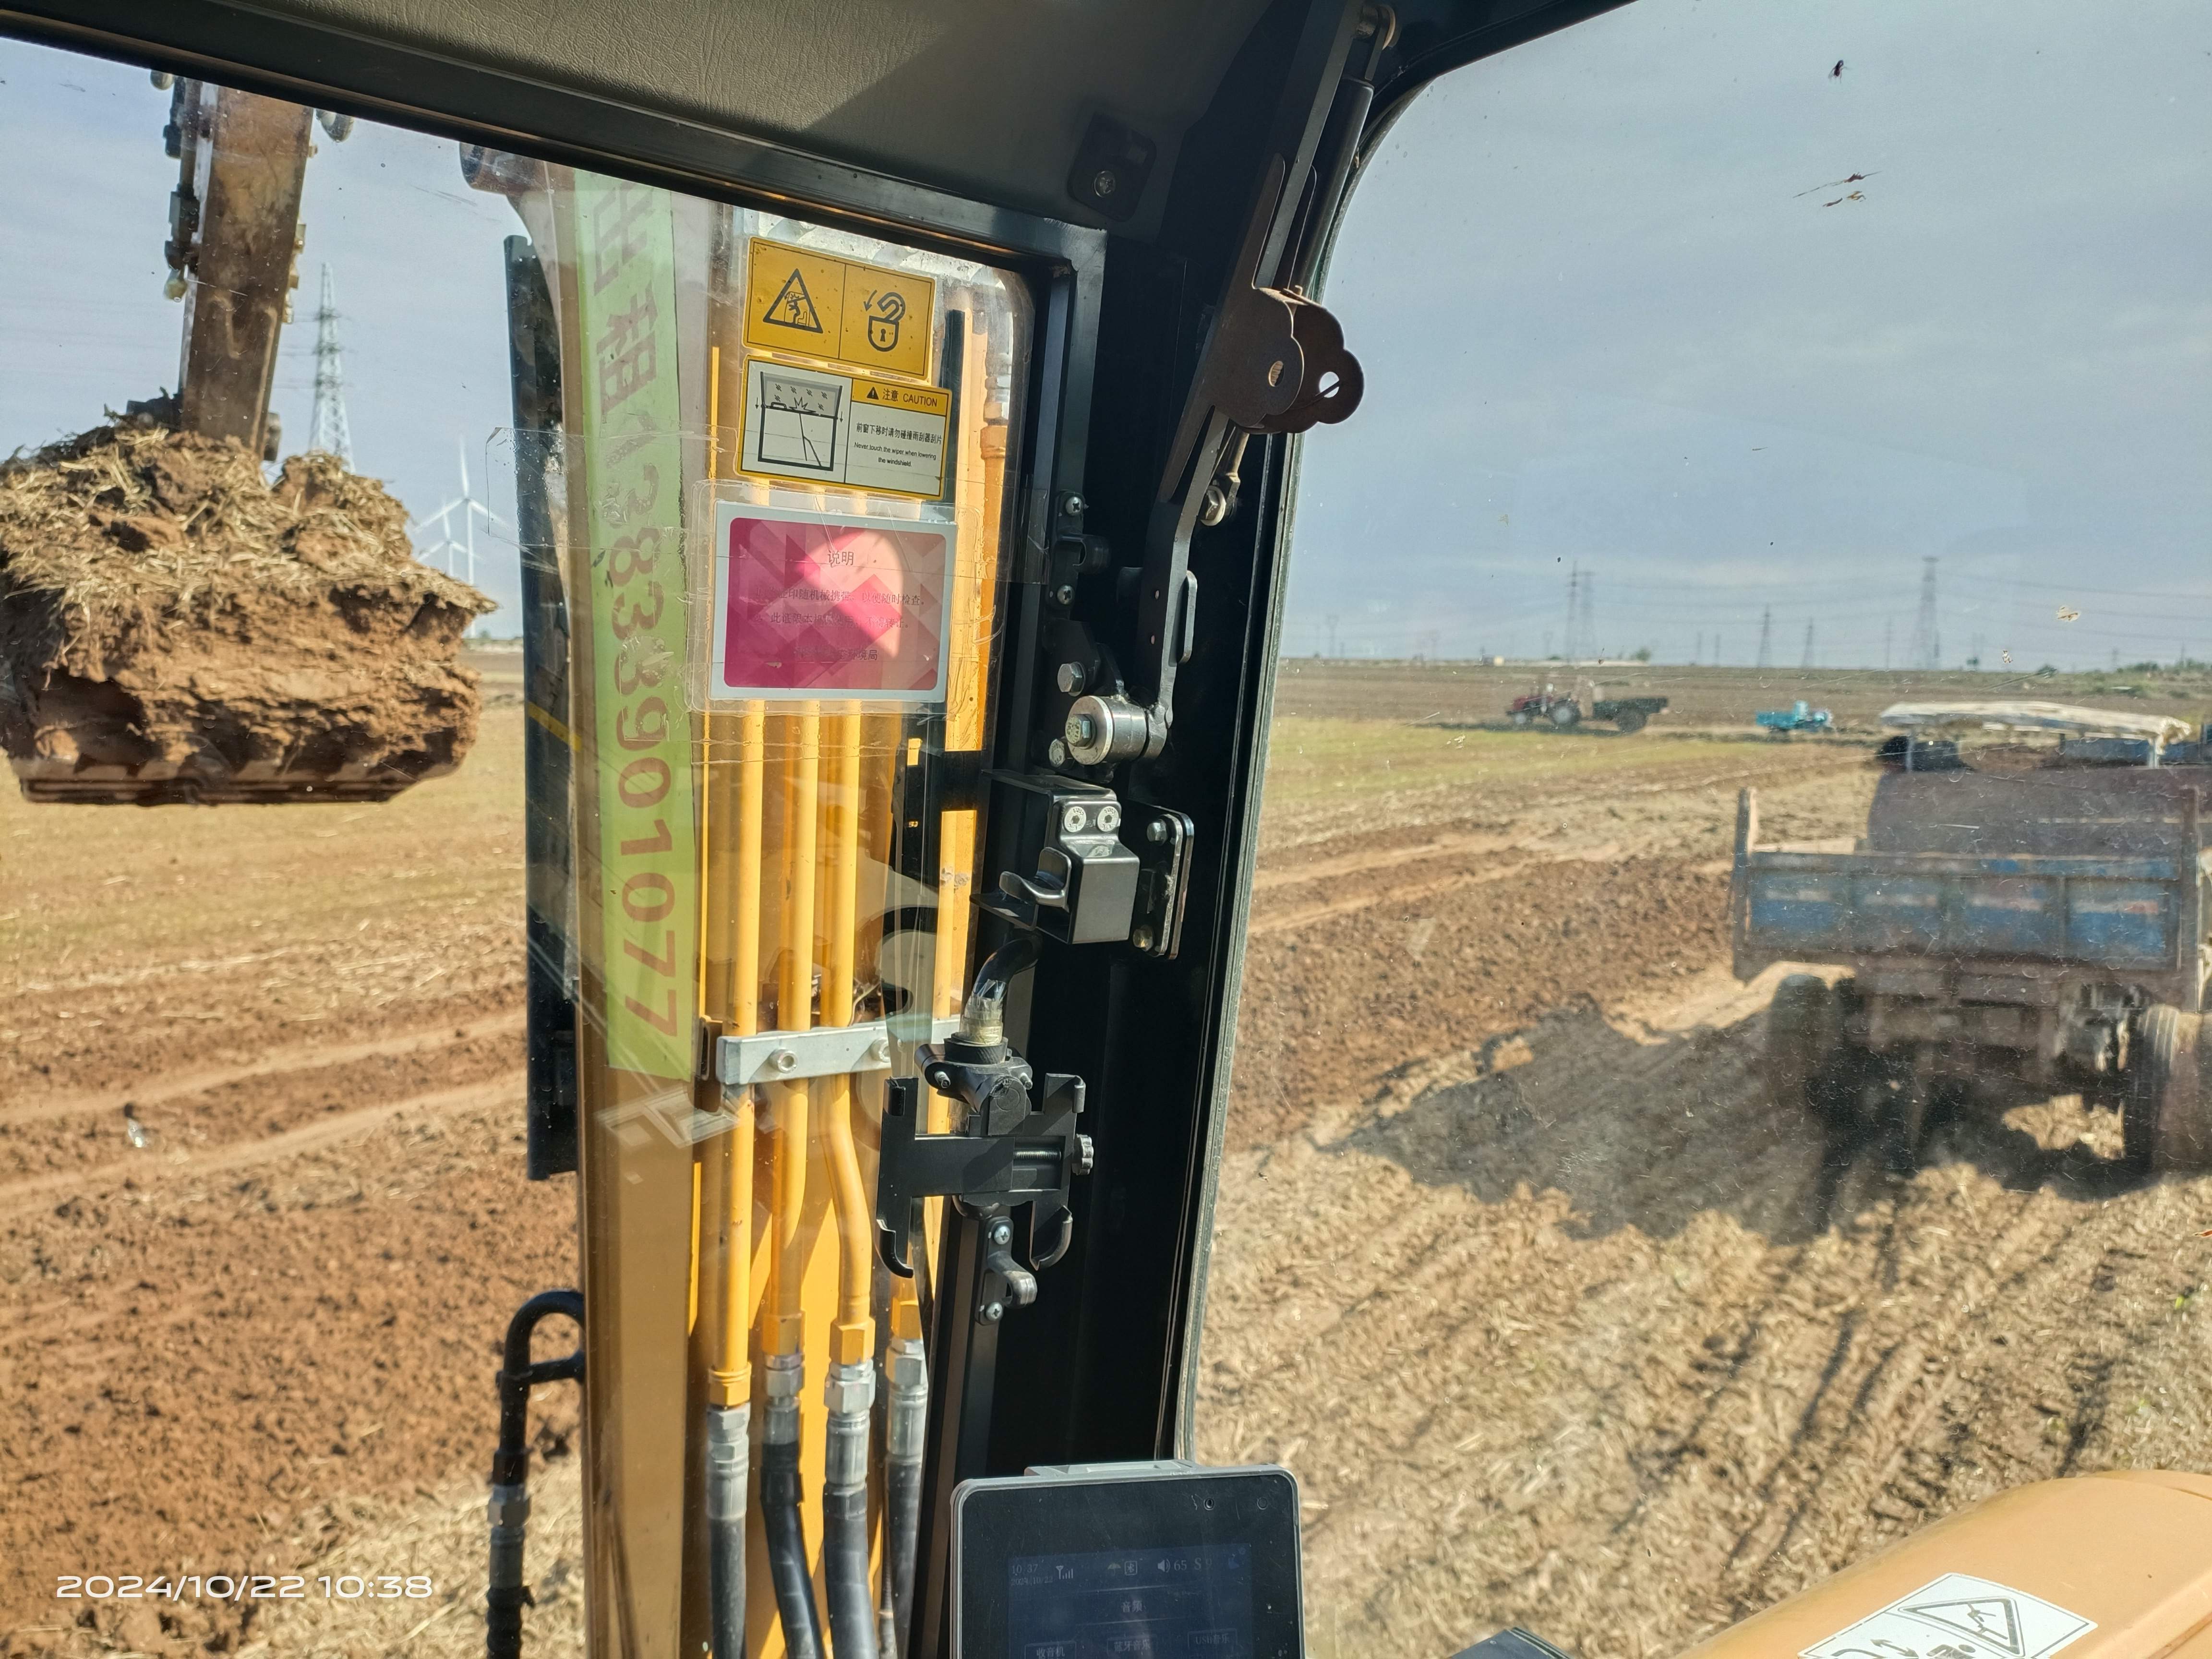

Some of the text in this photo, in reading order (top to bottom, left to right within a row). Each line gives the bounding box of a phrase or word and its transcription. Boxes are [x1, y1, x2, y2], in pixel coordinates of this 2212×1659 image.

[882, 388, 938, 407] 注意 CAUTION
[856, 422, 942, 445] 前窗下移时请勿碰撞雨刮器刮片
[854, 442, 868, 450] Never
[918, 451, 937, 460] lowering
[828, 549, 854, 566] 说明
[1174, 1560, 1187, 1571] 65
[1121, 1600, 1142, 1613] 音频
[1036, 1646, 1065, 1659] 收音机
[1114, 1639, 1151, 1652] 蓝牙音乐
